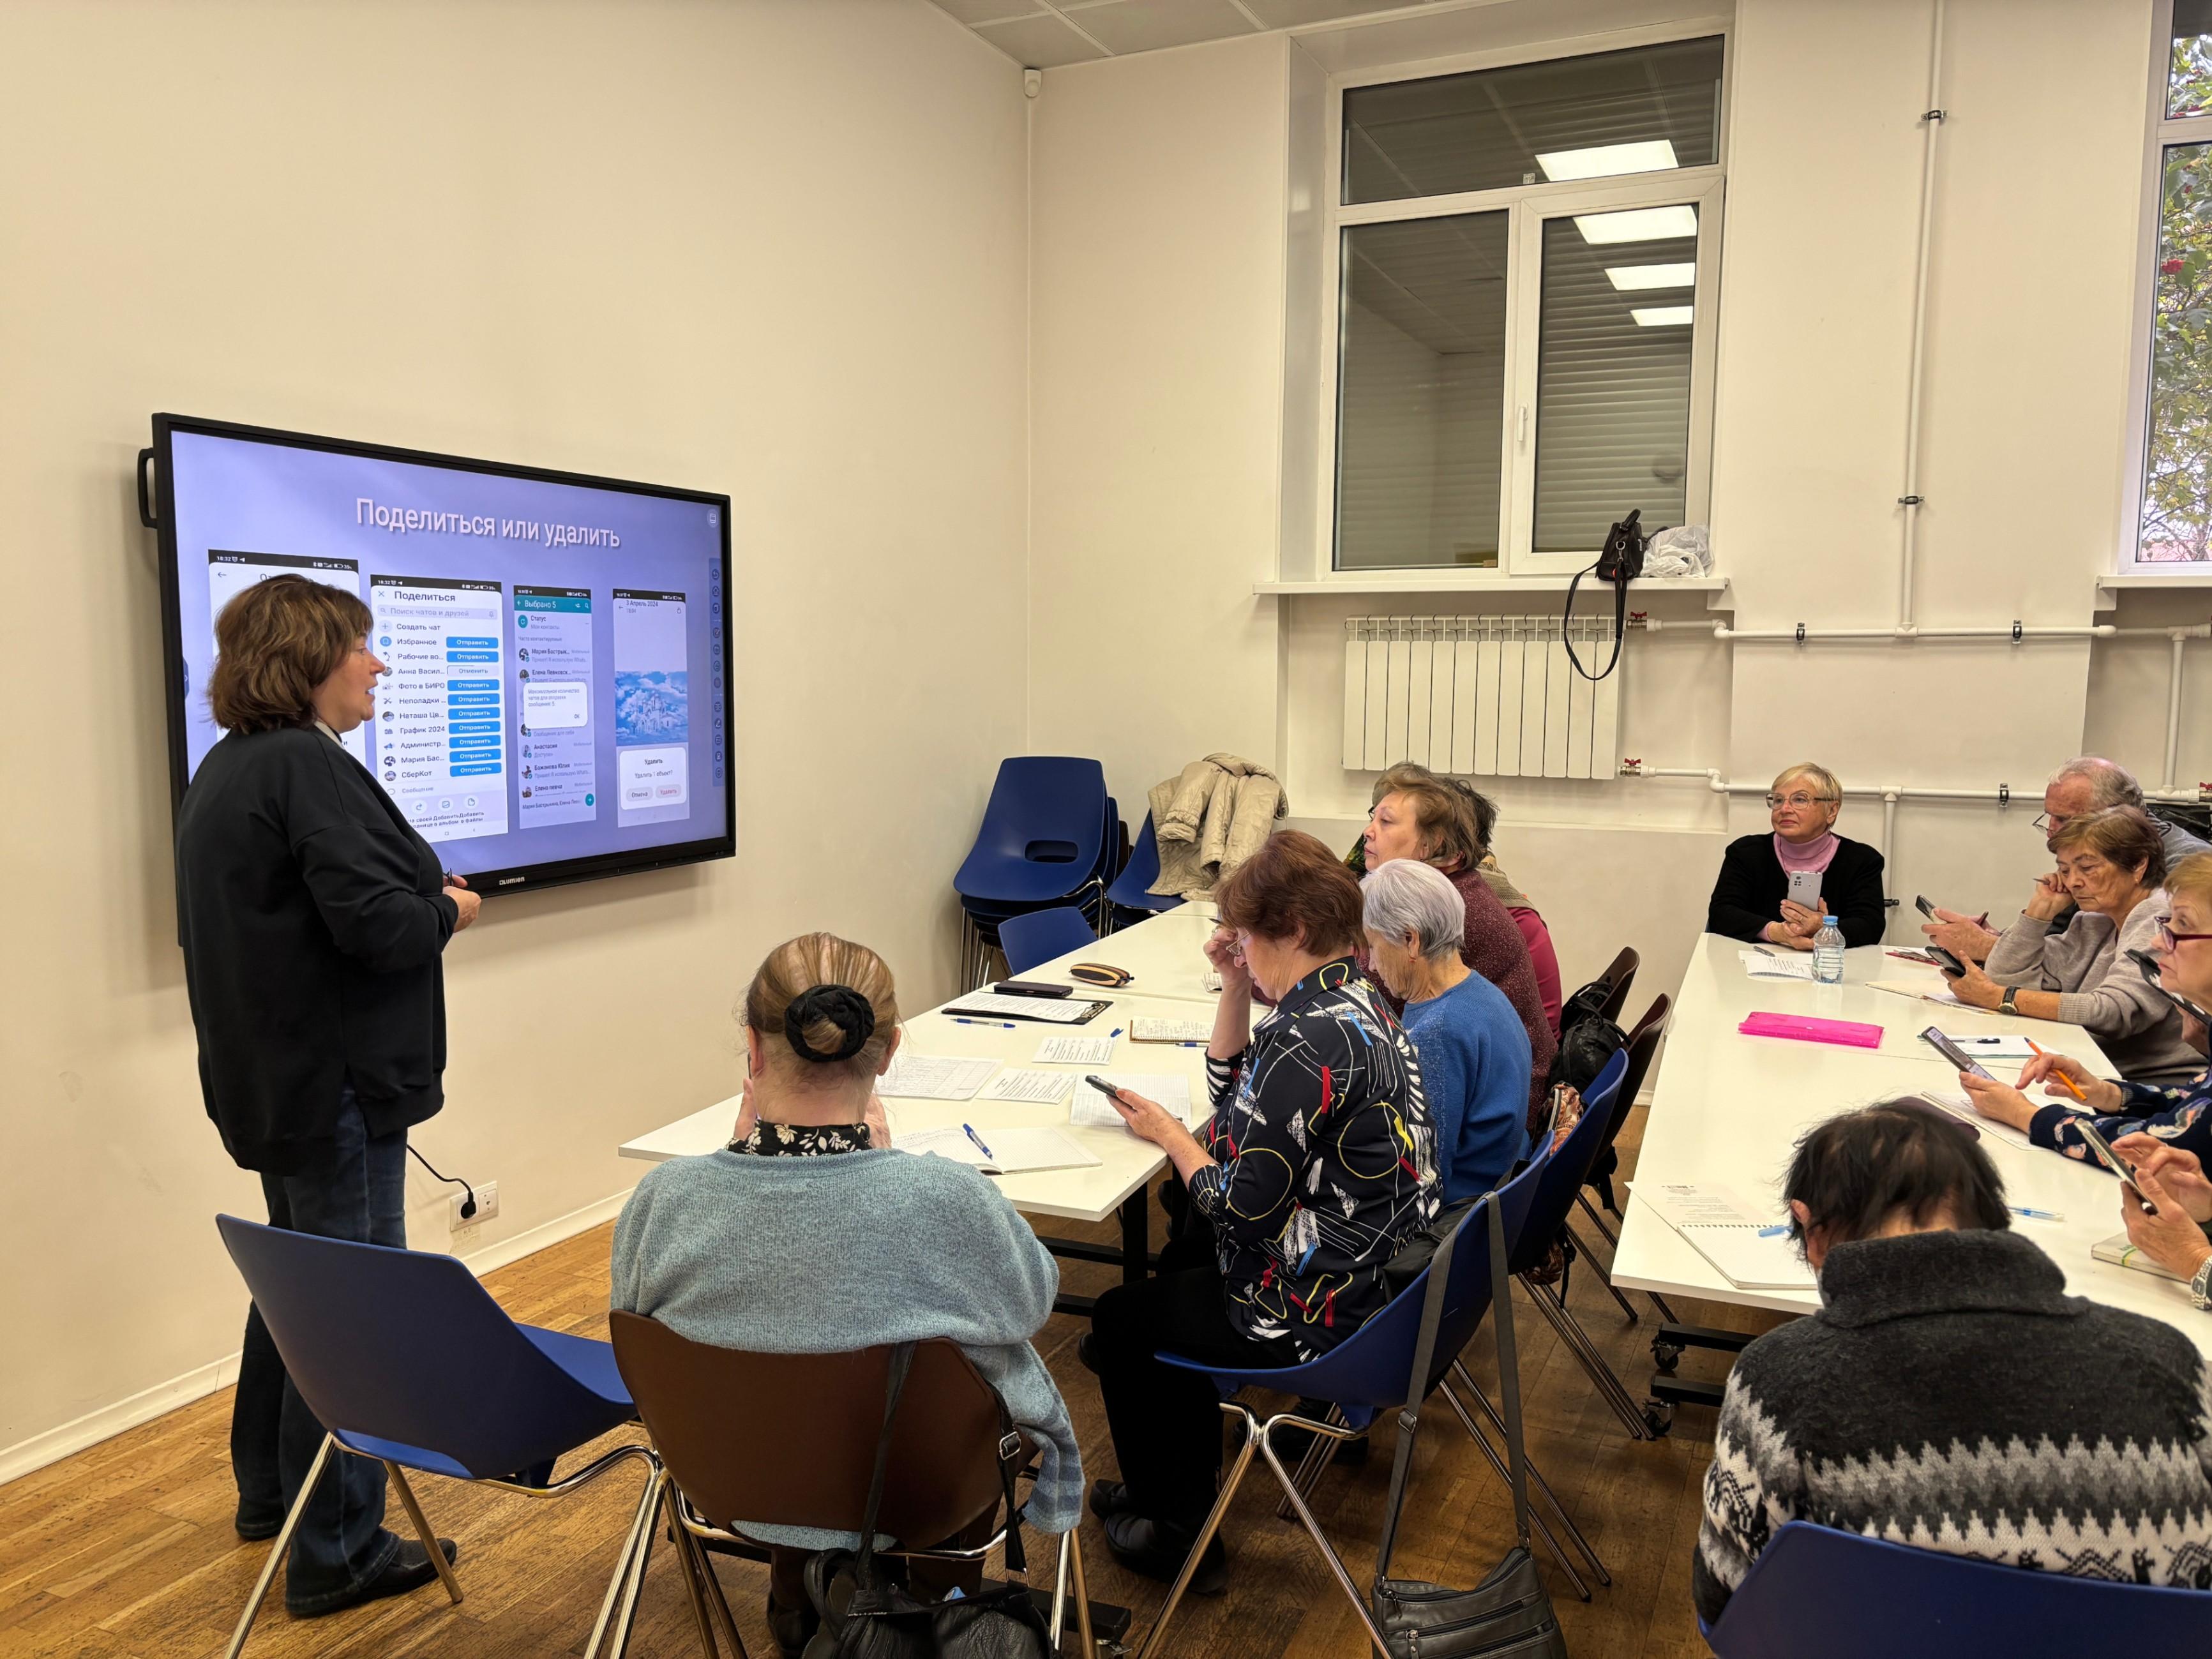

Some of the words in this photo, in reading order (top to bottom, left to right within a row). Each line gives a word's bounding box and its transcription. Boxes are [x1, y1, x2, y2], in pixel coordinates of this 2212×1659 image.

[356, 498, 495, 536] Поделиться
[502, 518, 539, 540] или
[545, 523, 621, 547] удалить
[395, 591, 455, 601] Поделиться
[525, 600, 551, 609] Выбрано
